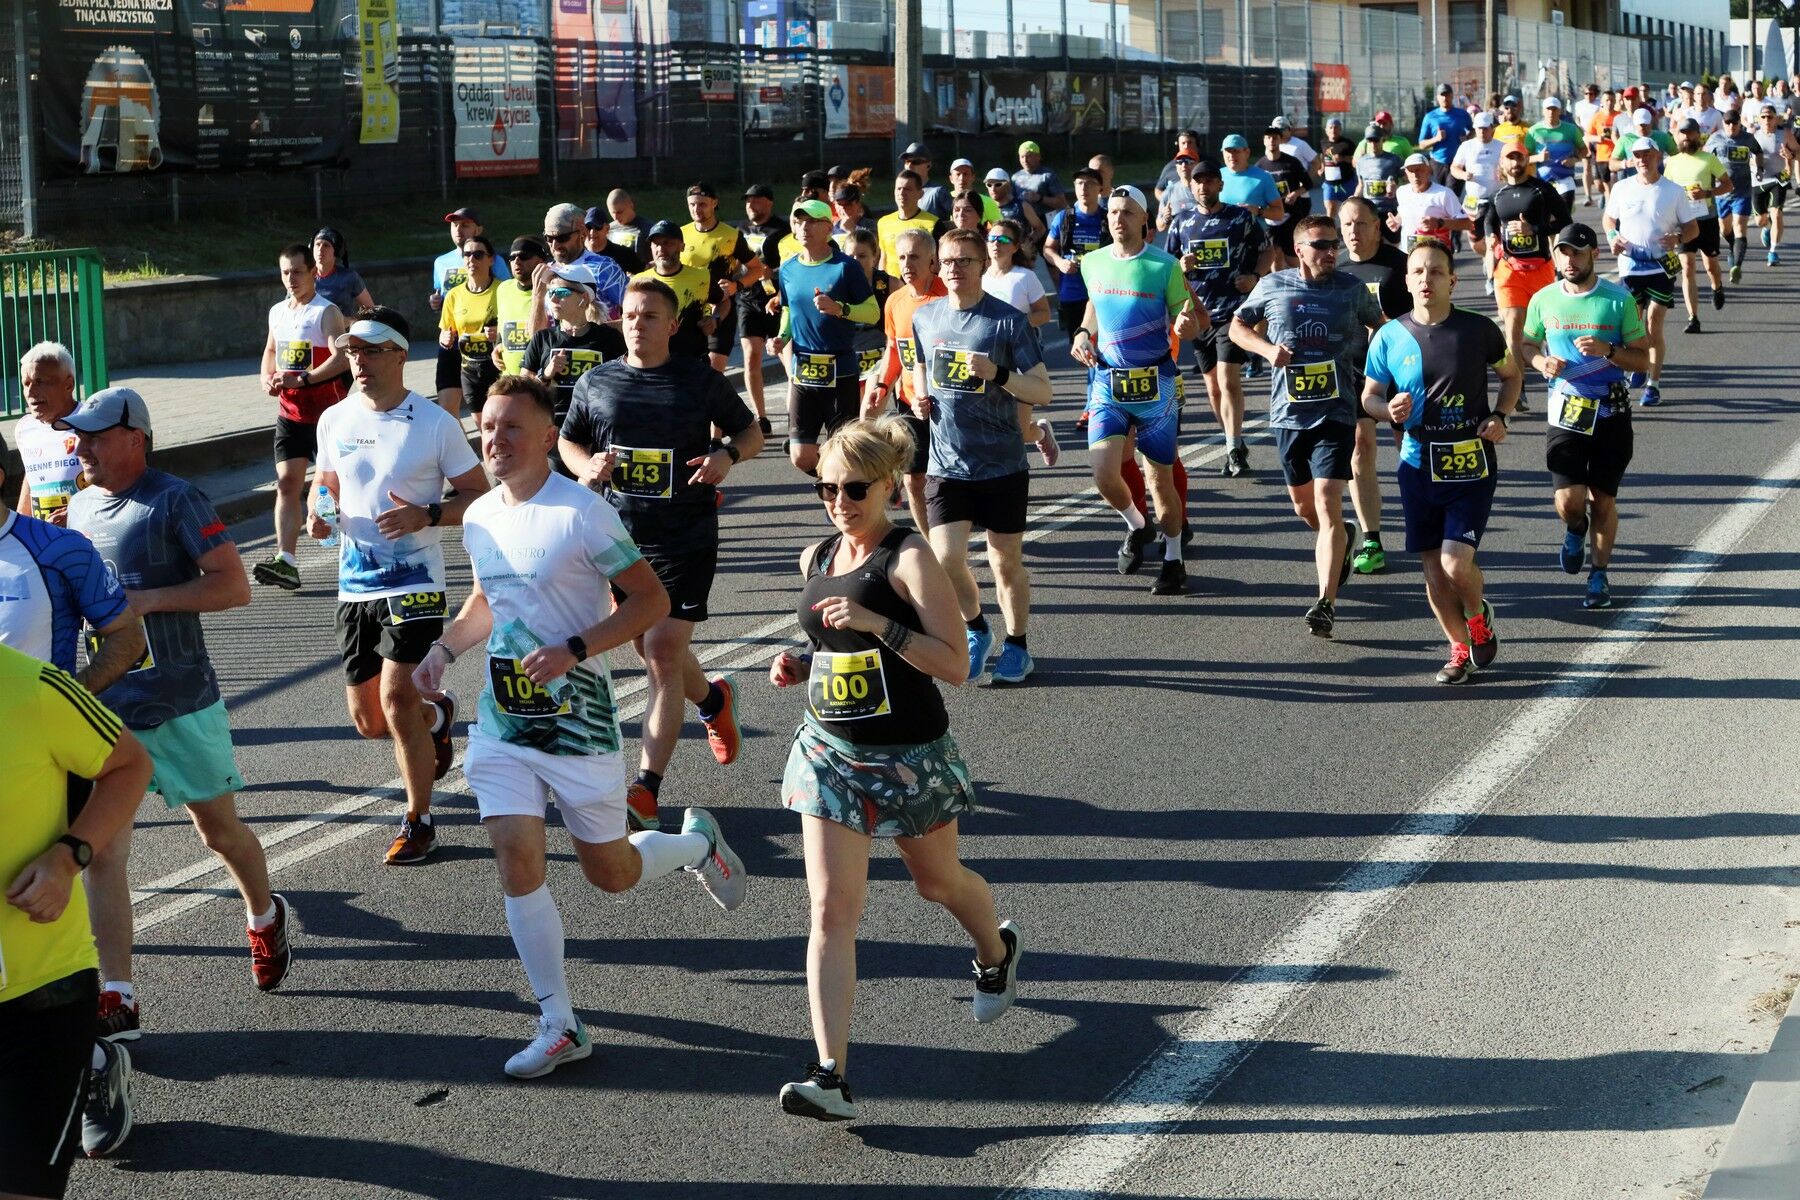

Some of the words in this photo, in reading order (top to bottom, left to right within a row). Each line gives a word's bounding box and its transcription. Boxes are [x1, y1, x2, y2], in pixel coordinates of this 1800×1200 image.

[74, 9, 107, 26] TNĄCA
[108, 10, 157, 24] WSZYSTKO.
[457, 83, 494, 107] Oddaj
[503, 83, 536, 105] Uratuj
[466, 102, 495, 121] krew
[984, 83, 1043, 126] Ceresit
[1511, 235, 1533, 246] 490
[1196, 248, 1222, 261] 334
[281, 349, 305, 363] 489
[464, 342, 488, 353] 643
[801, 363, 828, 378] 253
[1120, 379, 1150, 393] 118
[1295, 374, 1328, 391] 579
[1441, 393, 1465, 408] 1/2
[1441, 453, 1478, 470] 293
[620, 463, 660, 484] 143
[494, 547, 546, 561] MAESTRO
[503, 675, 549, 700] 104
[820, 674, 869, 701] 100
